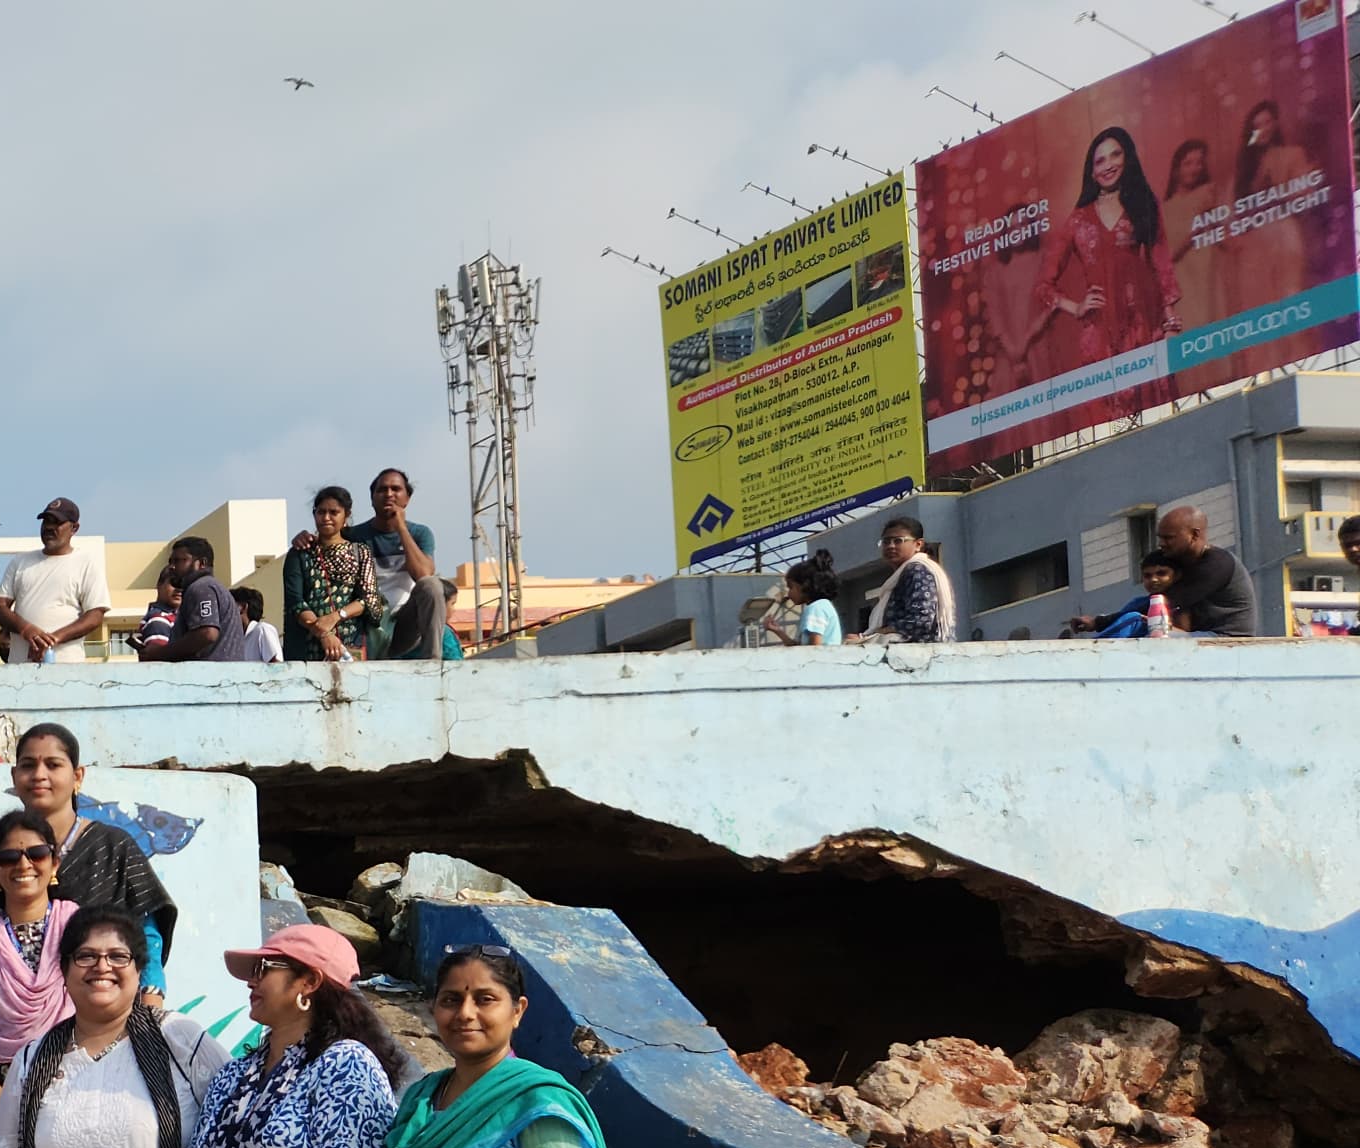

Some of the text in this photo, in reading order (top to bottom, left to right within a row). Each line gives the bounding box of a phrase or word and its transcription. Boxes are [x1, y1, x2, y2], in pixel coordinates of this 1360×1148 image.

[964, 199, 1050, 245] READY FOR
[1191, 169, 1324, 231] AND STEALING
[1192, 186, 1330, 251] THE SPOTLIGHT
[665, 181, 903, 310] SOMANI ISPAT PRIVATE LIMITED
[934, 219, 1051, 276] FESTIVE NIGHTS
[685, 377, 737, 406] Authorised
[739, 353, 793, 384] Distributor
[795, 348, 806, 361] of
[808, 334, 845, 357] Andhra
[847, 312, 893, 340] Pradesh
[735, 391, 751, 404] Plot
[753, 383, 767, 396] No.
[784, 364, 816, 384] D-Block
[846, 332, 895, 358] Autonagar,
[736, 386, 799, 418] Visakhapatnam
[841, 361, 860, 377] A.P.
[737, 436, 755, 449] Web
[757, 429, 772, 441] site
[779, 389, 877, 433] www.somanisteel.com
[971, 354, 1156, 427] DUSSEHRA KI EPPUDAINA READY
[737, 420, 754, 434] Mail
[756, 416, 764, 427] id
[738, 448, 766, 465] Contact
[891, 390, 911, 406] 4044
[769, 460, 820, 479] AUTHORITY
[823, 453, 837, 464] OF
[838, 442, 866, 460] INDIA
[867, 428, 908, 449] LIMITED
[200, 600, 212, 617] 5
